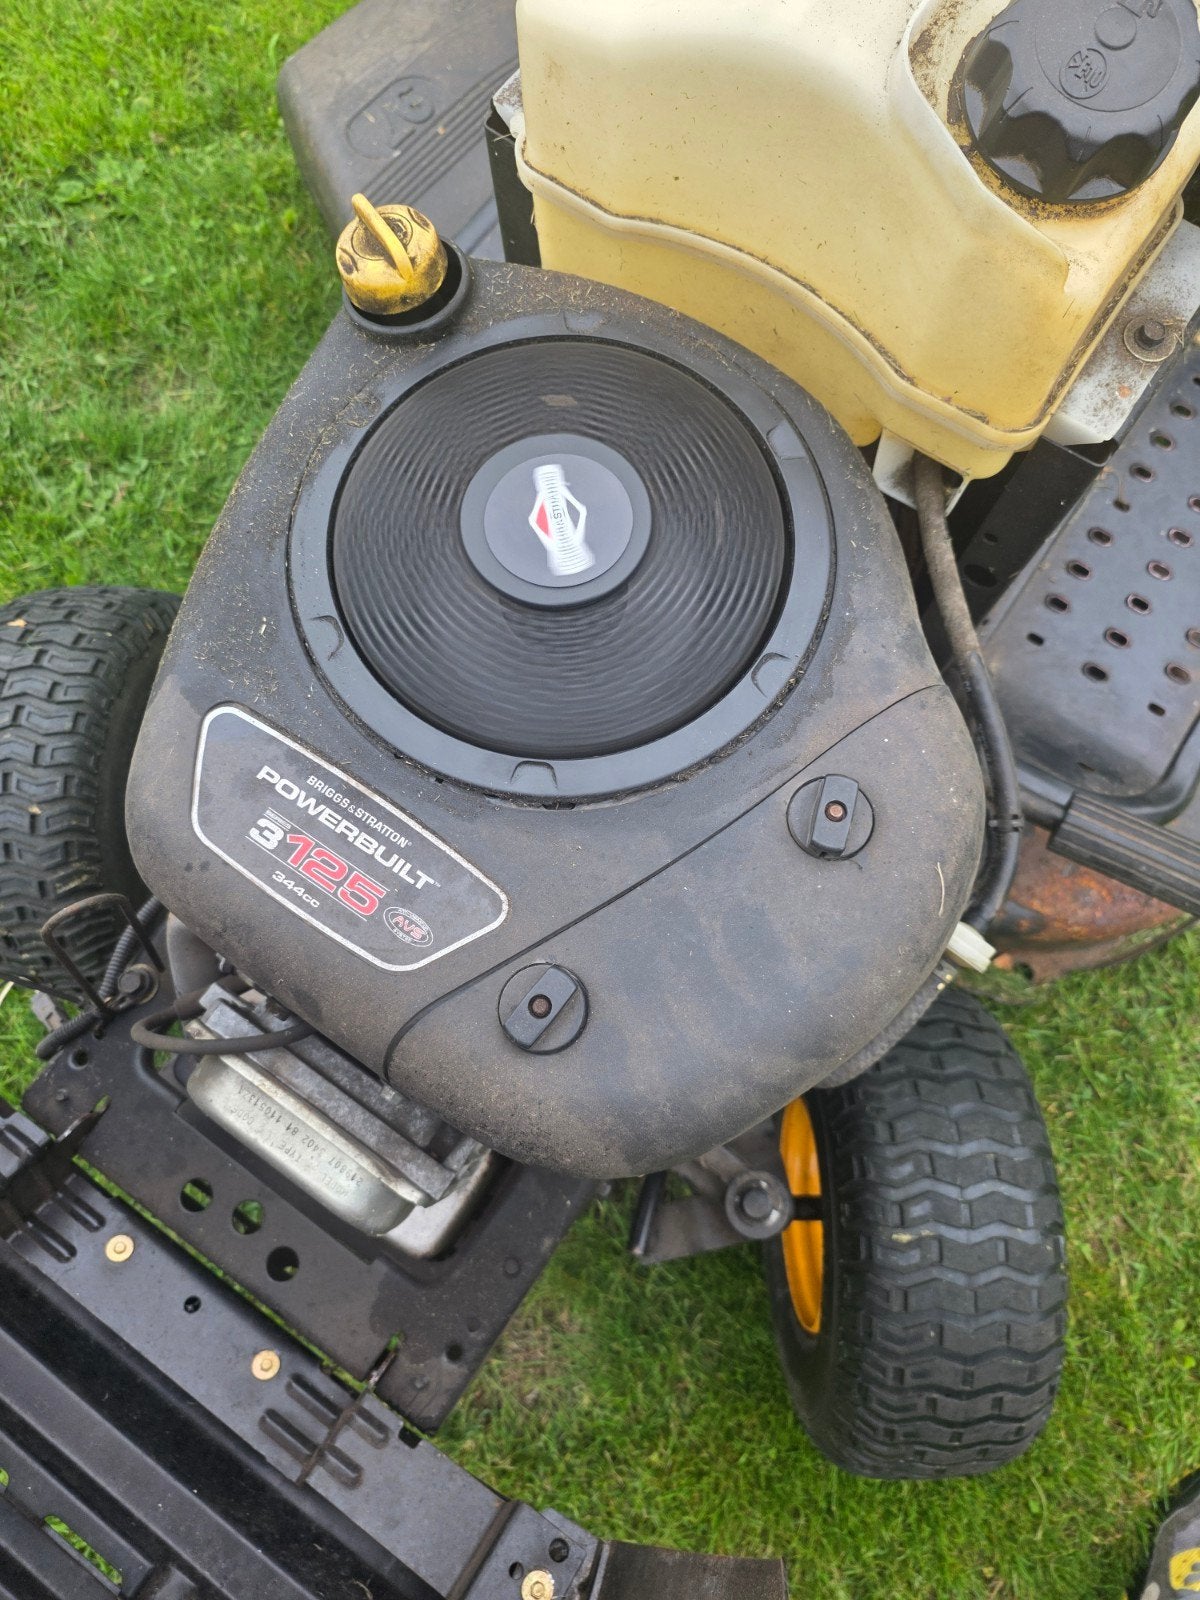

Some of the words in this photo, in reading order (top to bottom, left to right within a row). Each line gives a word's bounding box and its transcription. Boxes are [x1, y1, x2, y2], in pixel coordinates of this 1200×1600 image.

[272, 870, 320, 908] 344cc
[392, 915, 426, 939] AVS
[279, 1142, 301, 1162] TYPE
